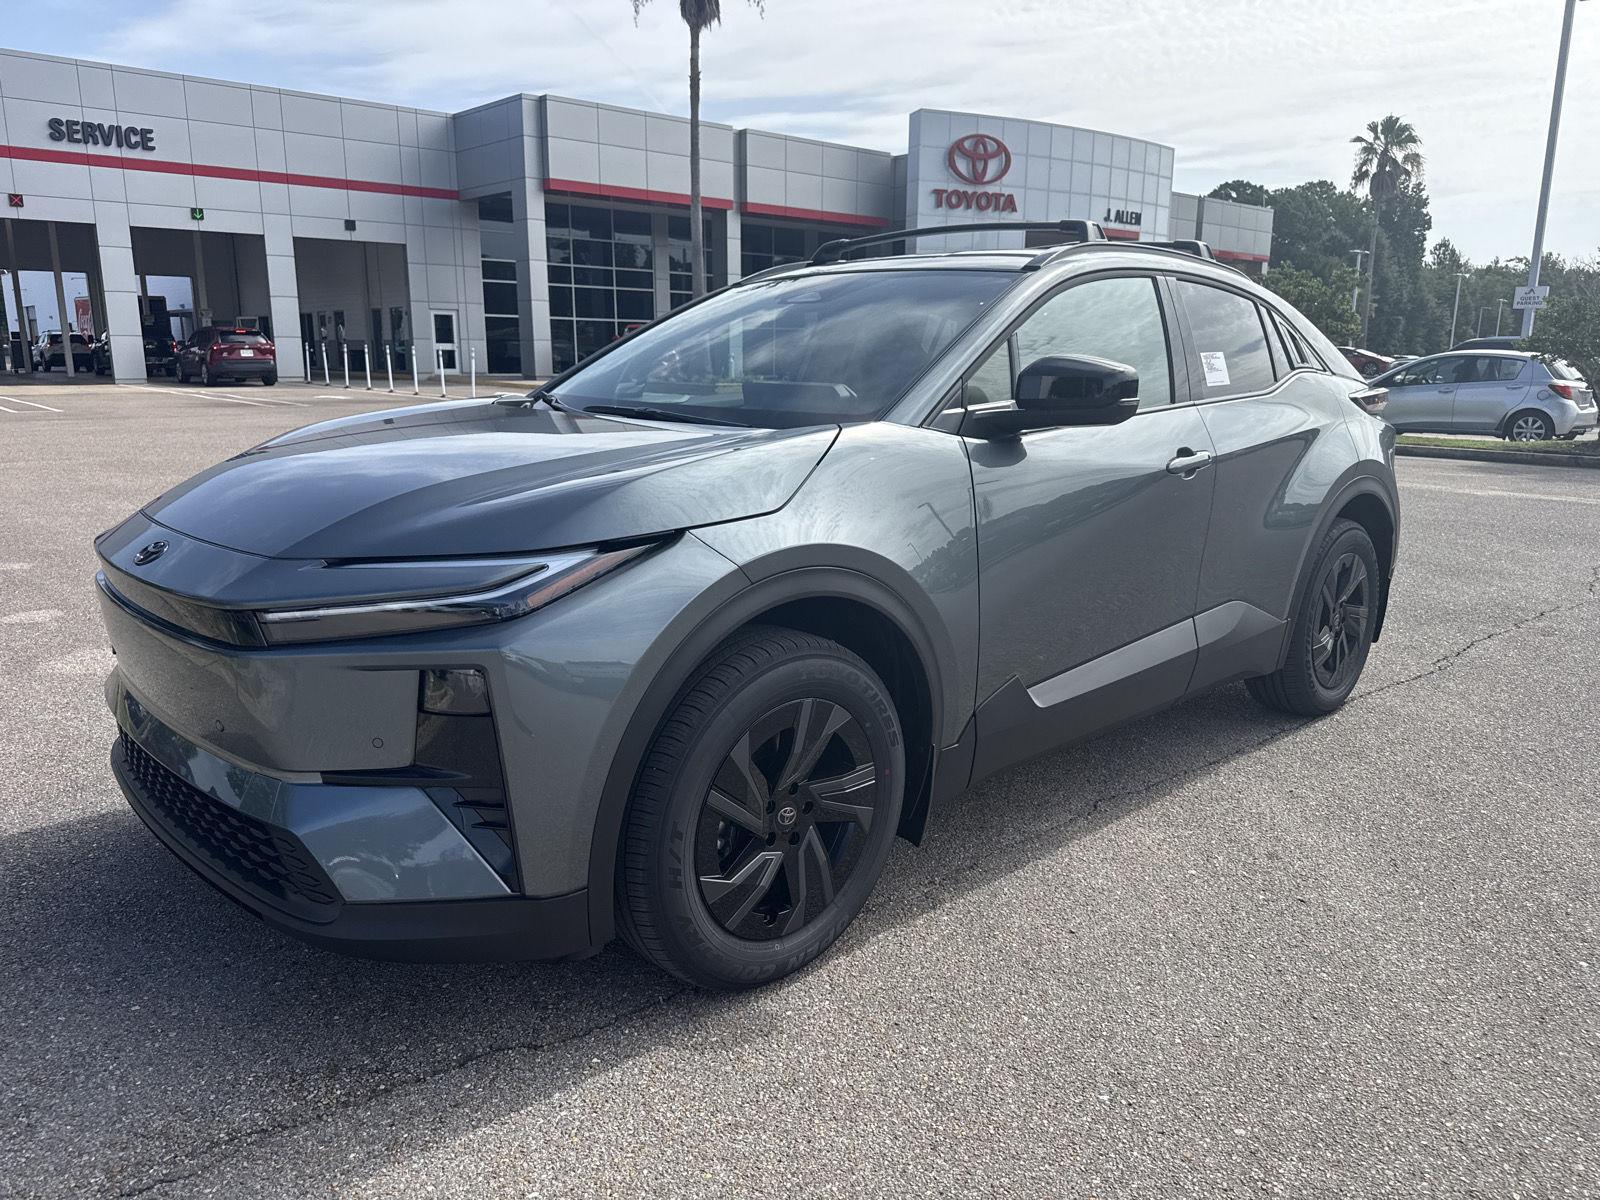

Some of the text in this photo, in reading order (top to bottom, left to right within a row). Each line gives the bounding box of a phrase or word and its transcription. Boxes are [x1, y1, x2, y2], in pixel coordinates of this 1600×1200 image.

[48, 117, 156, 151] SERVICE
[932, 188, 1017, 213] TOYOTA
[1103, 207, 1142, 226] J. ALLEN
